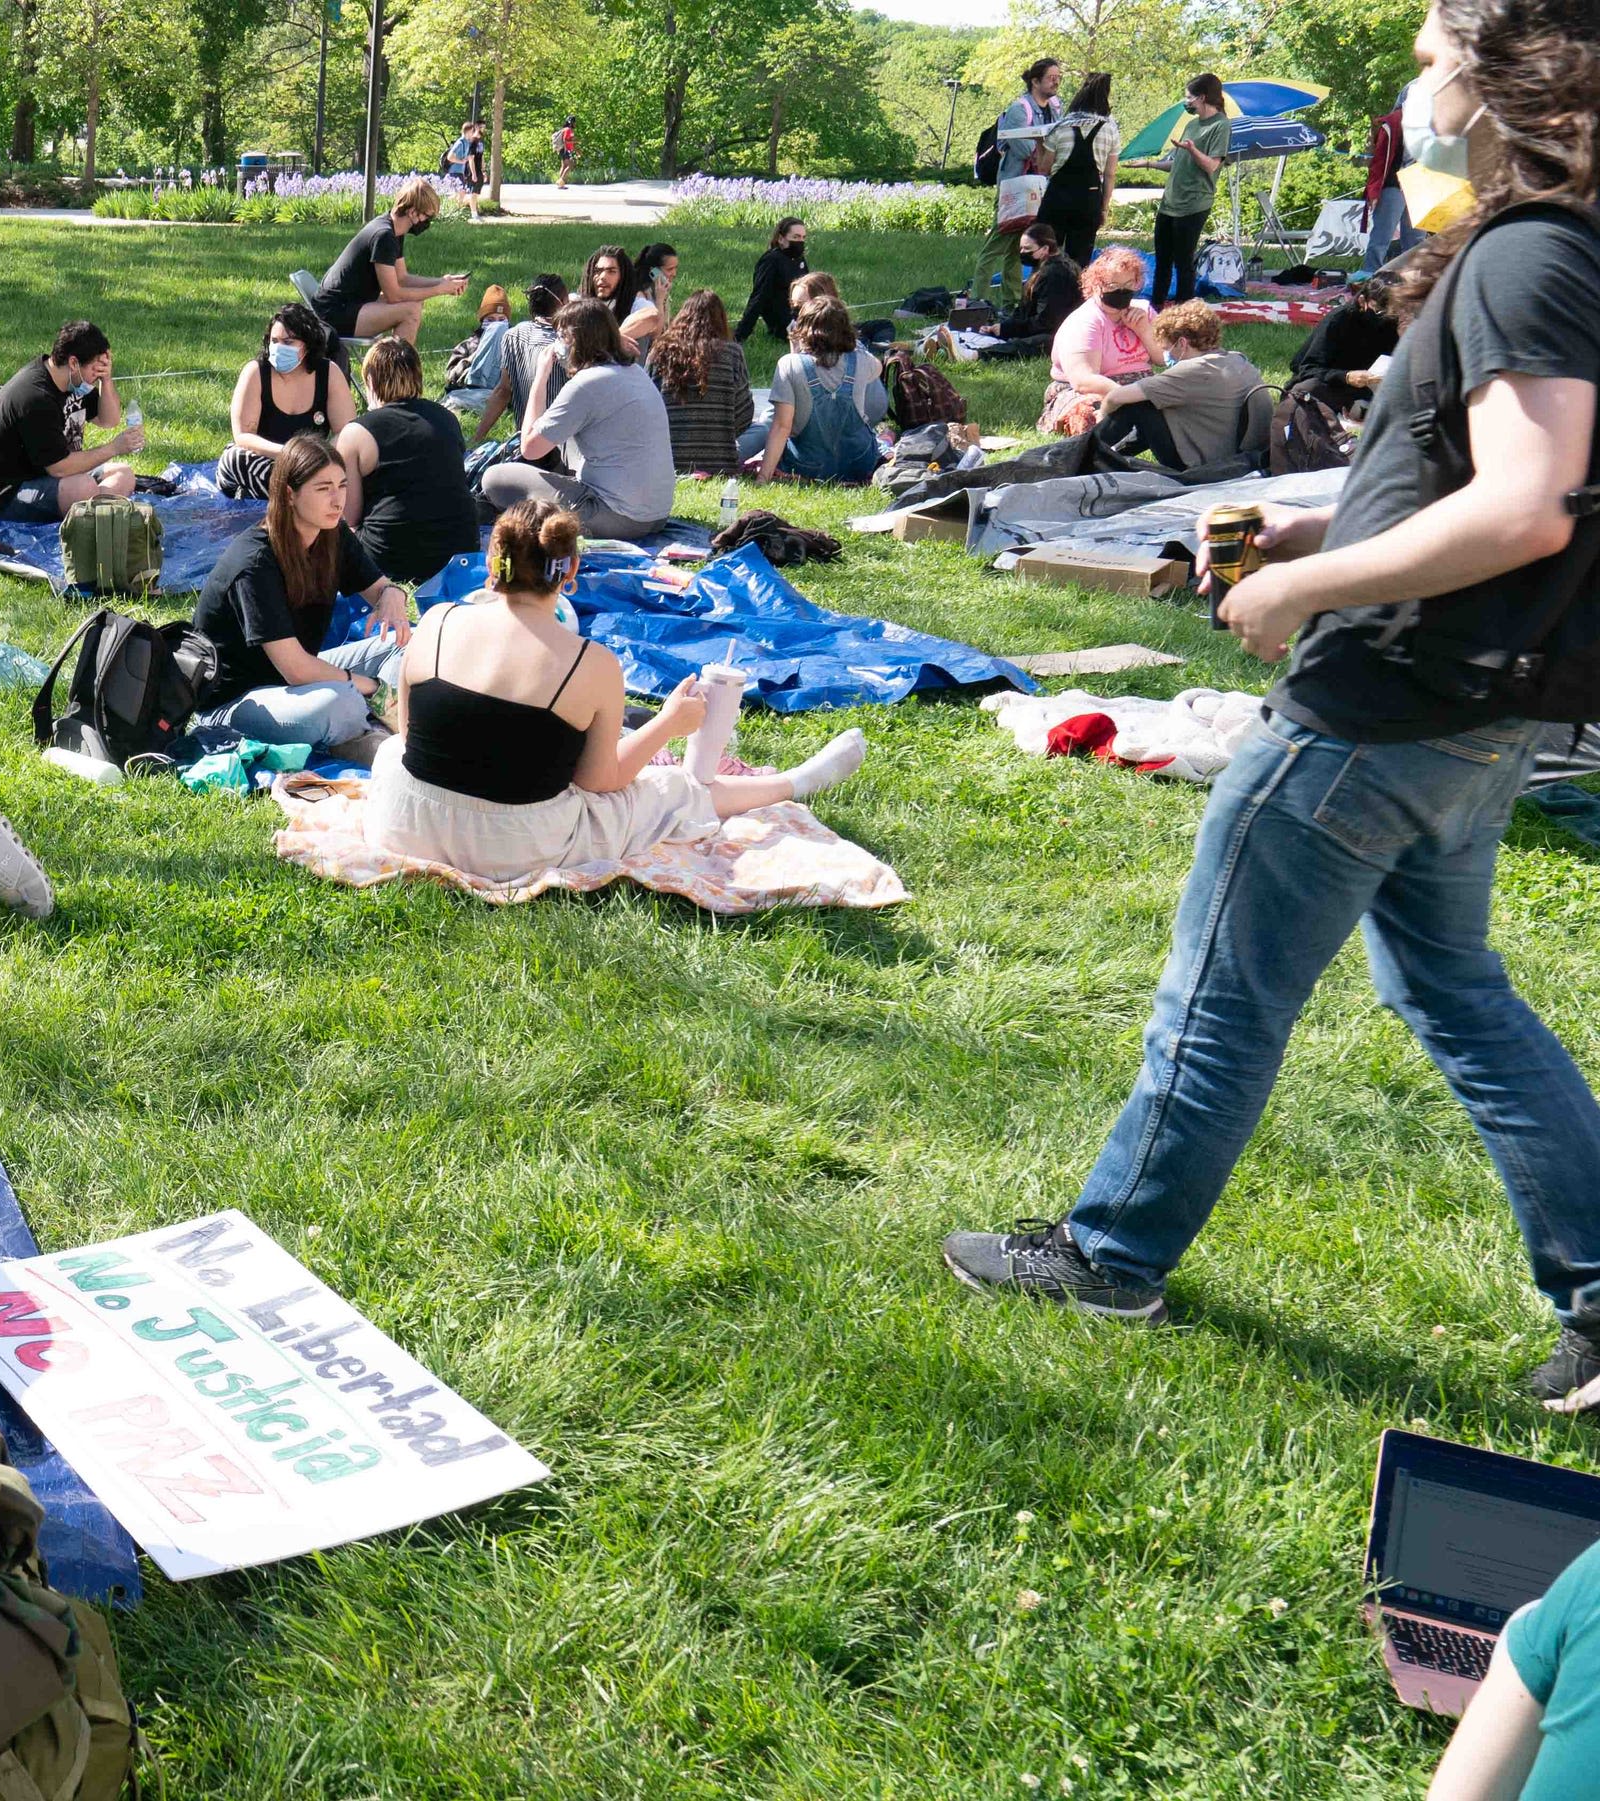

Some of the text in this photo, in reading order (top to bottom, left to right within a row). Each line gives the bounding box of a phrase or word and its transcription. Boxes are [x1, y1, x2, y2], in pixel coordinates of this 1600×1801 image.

[55, 1251, 383, 1485] No Justicia
[68, 1393, 265, 1524] PAZ
[153, 1218, 510, 1468] No Libertad
